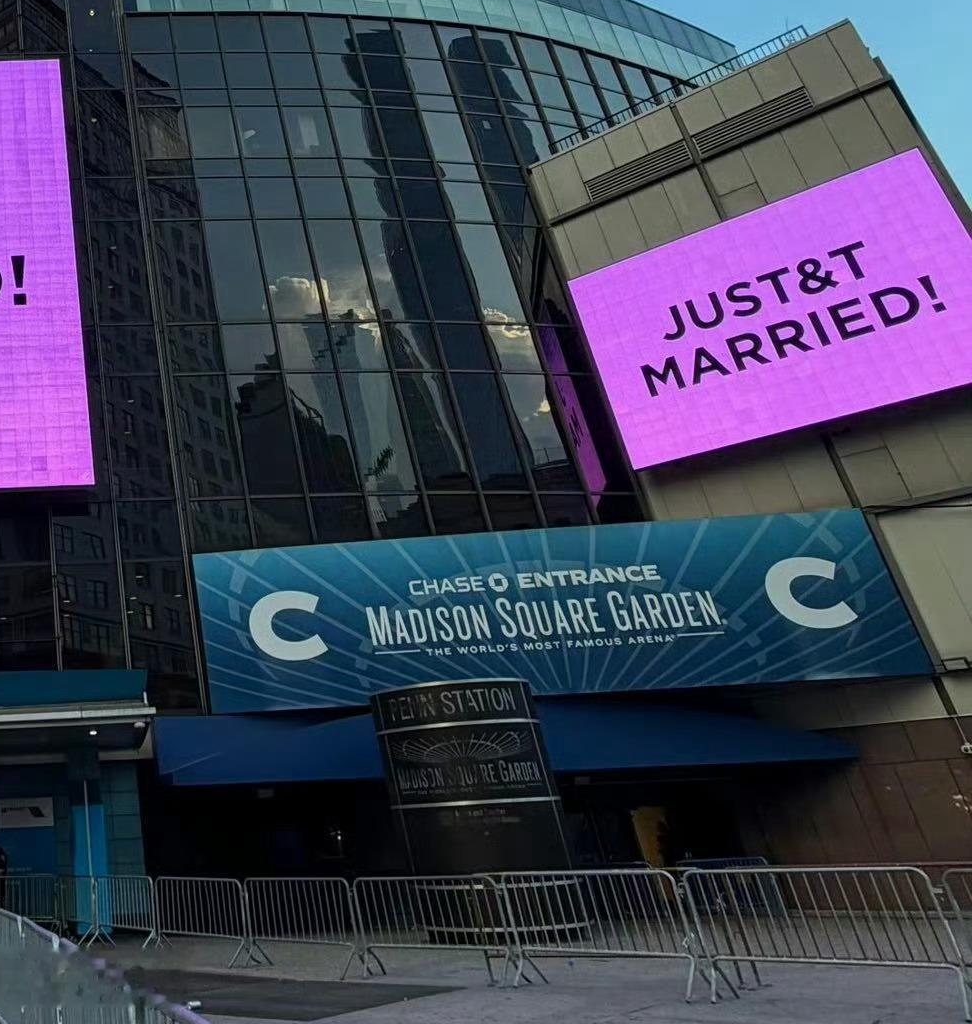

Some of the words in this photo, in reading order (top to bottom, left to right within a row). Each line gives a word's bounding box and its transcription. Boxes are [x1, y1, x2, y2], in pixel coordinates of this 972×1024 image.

[662, 241, 867, 340] JUST&T
[640, 274, 948, 397] MARRIED!
[408, 575, 487, 597] CHASE
[518, 564, 662, 590] ENTRANCE
[765, 556, 859, 629] C
[248, 590, 330, 662] C
[365, 604, 493, 647] MADISON
[495, 596, 606, 641] SQUARE
[425, 647, 453, 657] THE
[456, 643, 519, 655] WORLD'S
[524, 640, 561, 651] MOST
[566, 637, 623, 649] FAMOUS
[440, 687, 516, 715] STATION
